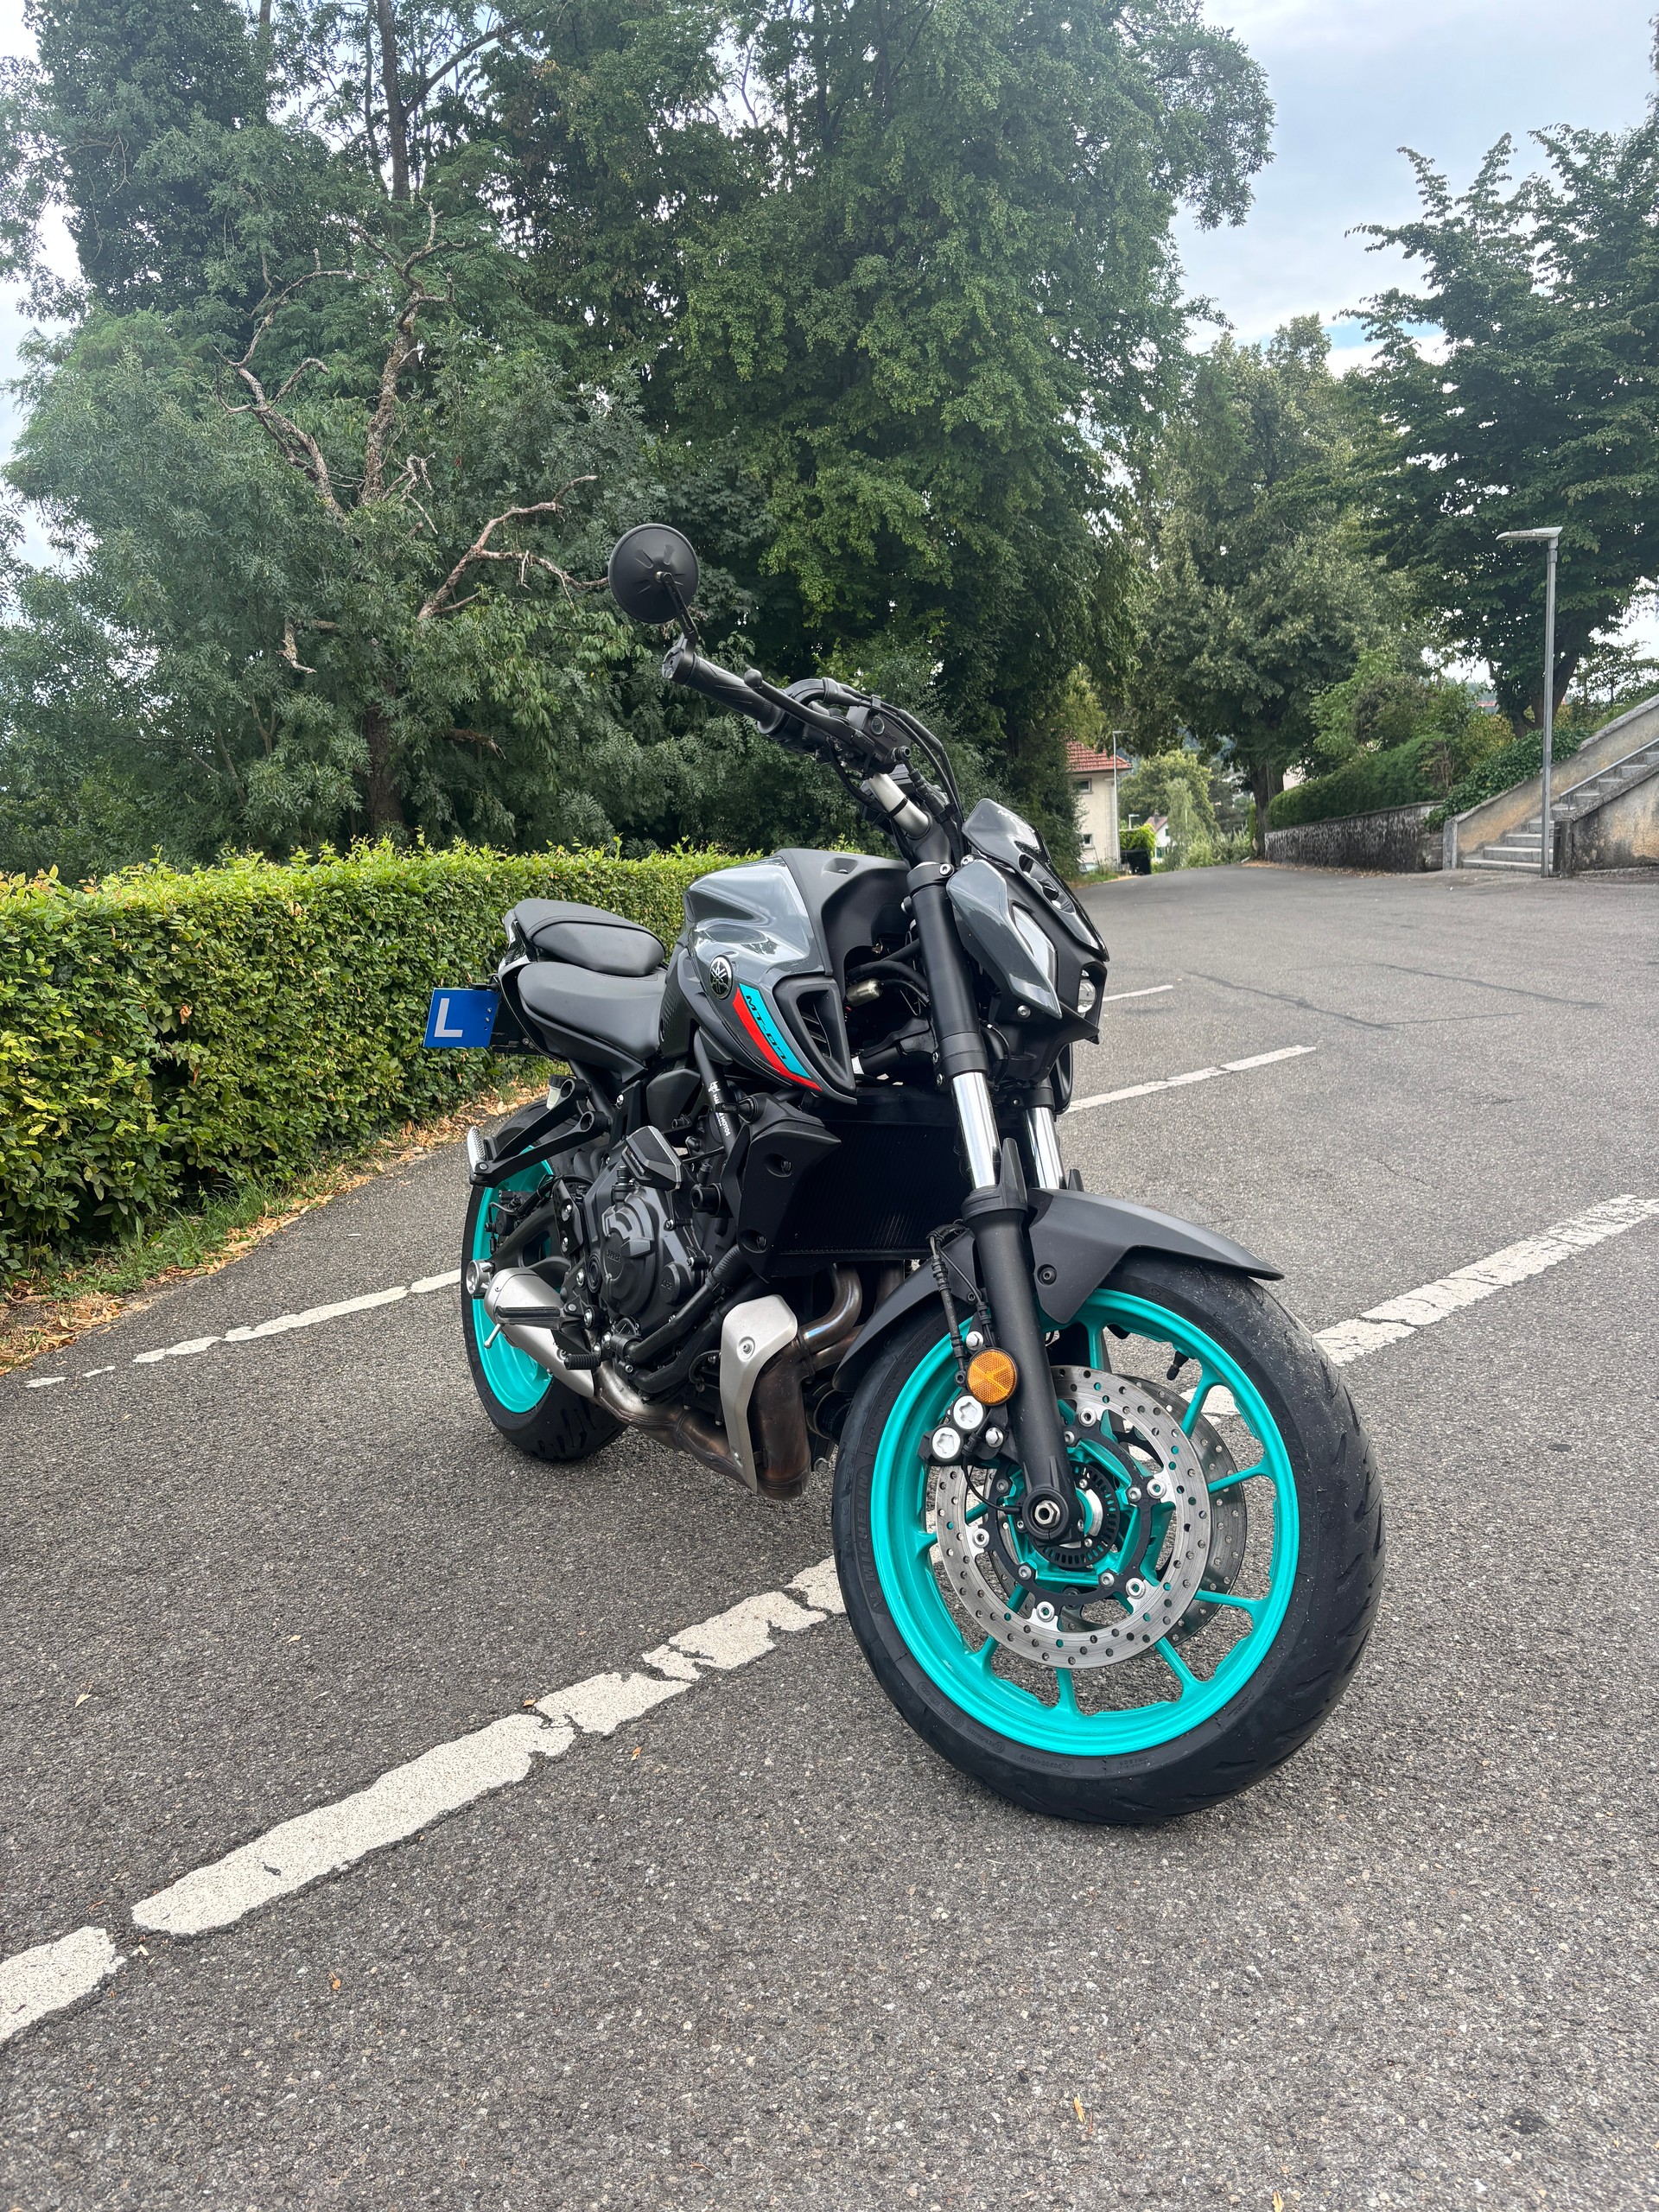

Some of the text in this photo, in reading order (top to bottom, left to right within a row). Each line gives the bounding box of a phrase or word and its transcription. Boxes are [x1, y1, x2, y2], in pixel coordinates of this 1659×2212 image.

[434, 997, 464, 1038] L
[746, 995, 787, 1060] MT-07
[857, 1473, 875, 1583] MICHELIN
